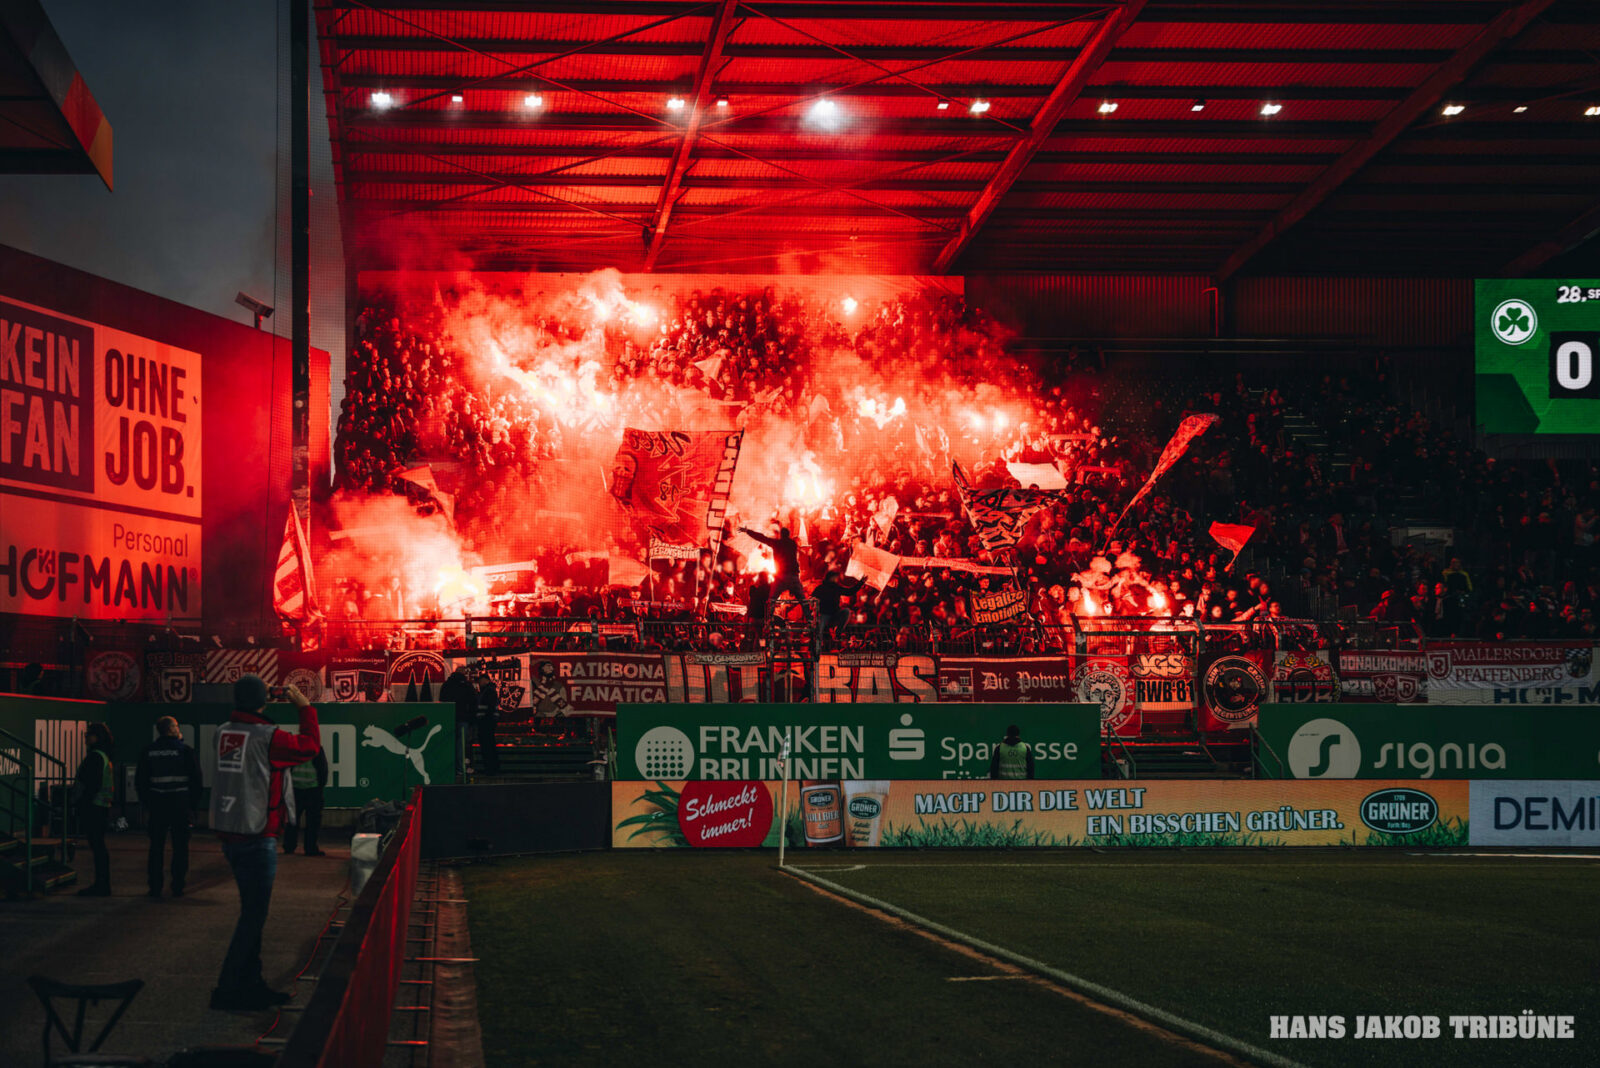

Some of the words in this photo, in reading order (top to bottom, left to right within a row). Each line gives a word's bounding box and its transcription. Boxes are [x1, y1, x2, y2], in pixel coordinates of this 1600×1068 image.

[1557, 285, 1587, 303] 28.
[1, 319, 79, 398] KEIN
[1556, 341, 1593, 390] 0
[104, 348, 187, 423] OHNE
[1, 389, 79, 477] FAN
[104, 416, 194, 498] JOB.
[112, 523, 189, 558] Personal
[972, 590, 1024, 611] Legalize
[975, 602, 1025, 623] Emotions
[1131, 653, 1183, 677] JGS
[1452, 646, 1563, 661] MALLERSDORF
[560, 661, 665, 679] RATISBONA
[981, 671, 1011, 691] Die
[1015, 670, 1067, 694] Power
[1455, 666, 1563, 682] PFAFFENBERG
[570, 685, 667, 702] FANATICA
[700, 726, 864, 753] FRANKEN
[940, 736, 1078, 767] Sparsse
[1374, 742, 1506, 779] signia
[685, 784, 759, 822] Schmeckt
[914, 793, 985, 814] MACH'
[992, 791, 1034, 812] DIR
[1039, 790, 1079, 811] DIE
[1085, 788, 1147, 809] WELT
[700, 808, 754, 841] immer!
[1087, 815, 1123, 836] EIN
[1129, 812, 1241, 834] BISSCHEN
[1246, 806, 1345, 832] GRÜNER.
